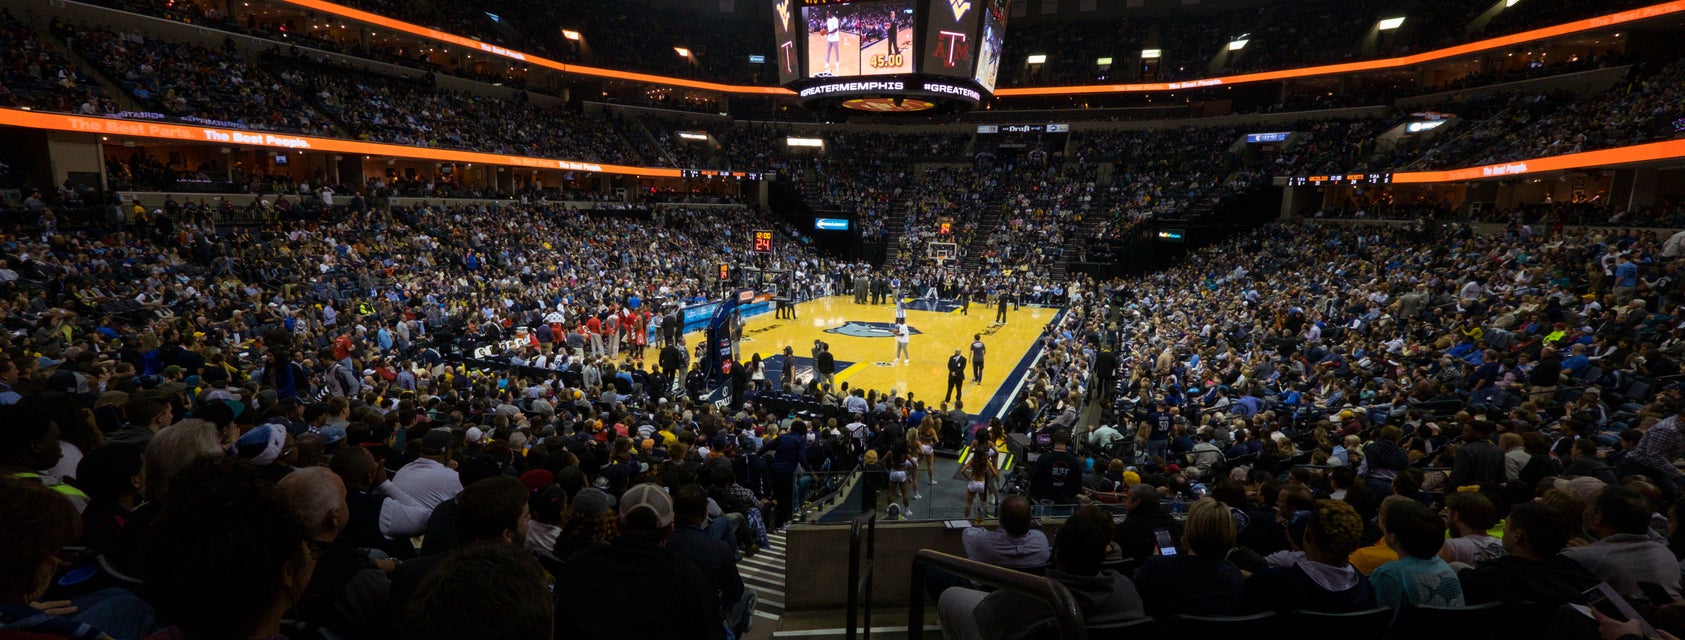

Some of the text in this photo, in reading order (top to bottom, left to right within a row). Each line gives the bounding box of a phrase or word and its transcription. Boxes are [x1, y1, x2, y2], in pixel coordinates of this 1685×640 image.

[68, 118, 101, 130] The
[106, 122, 145, 134] Best
[204, 129, 310, 148] The Best People.
[756, 239, 770, 250] 24
[1158, 420, 1169, 431] 50
